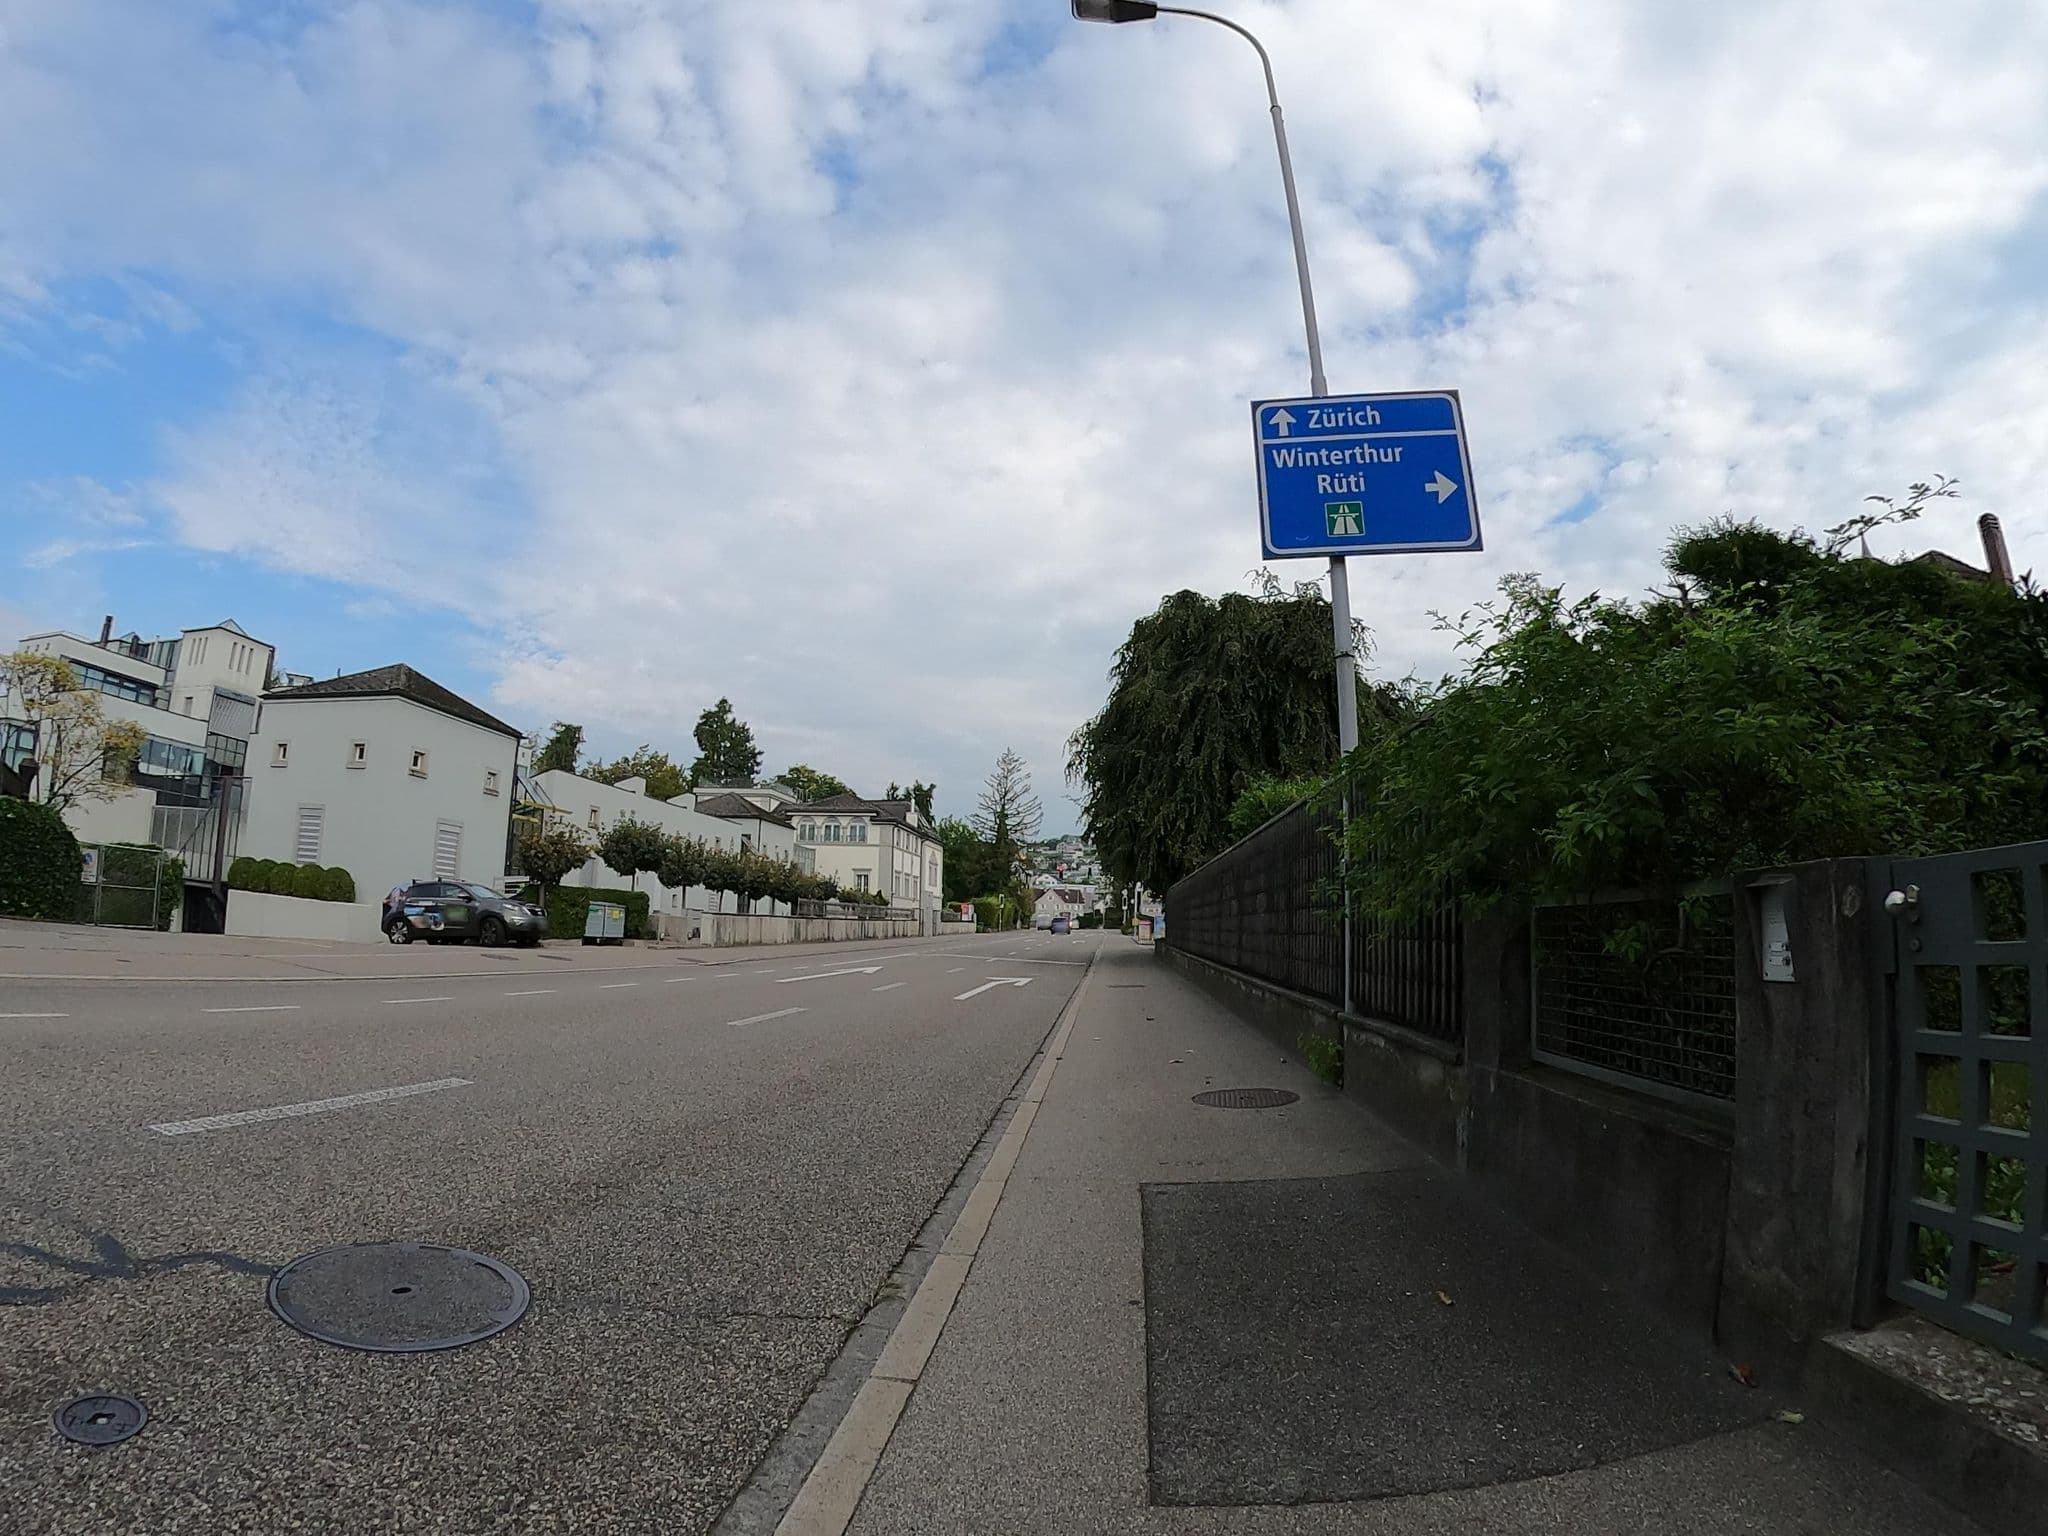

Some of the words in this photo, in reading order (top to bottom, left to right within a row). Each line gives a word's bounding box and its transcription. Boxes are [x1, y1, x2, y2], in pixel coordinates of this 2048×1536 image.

[1307, 405, 1381, 429] Zürich
[1272, 443, 1403, 468] Winterthur
[1317, 472, 1365, 494] Rüti
